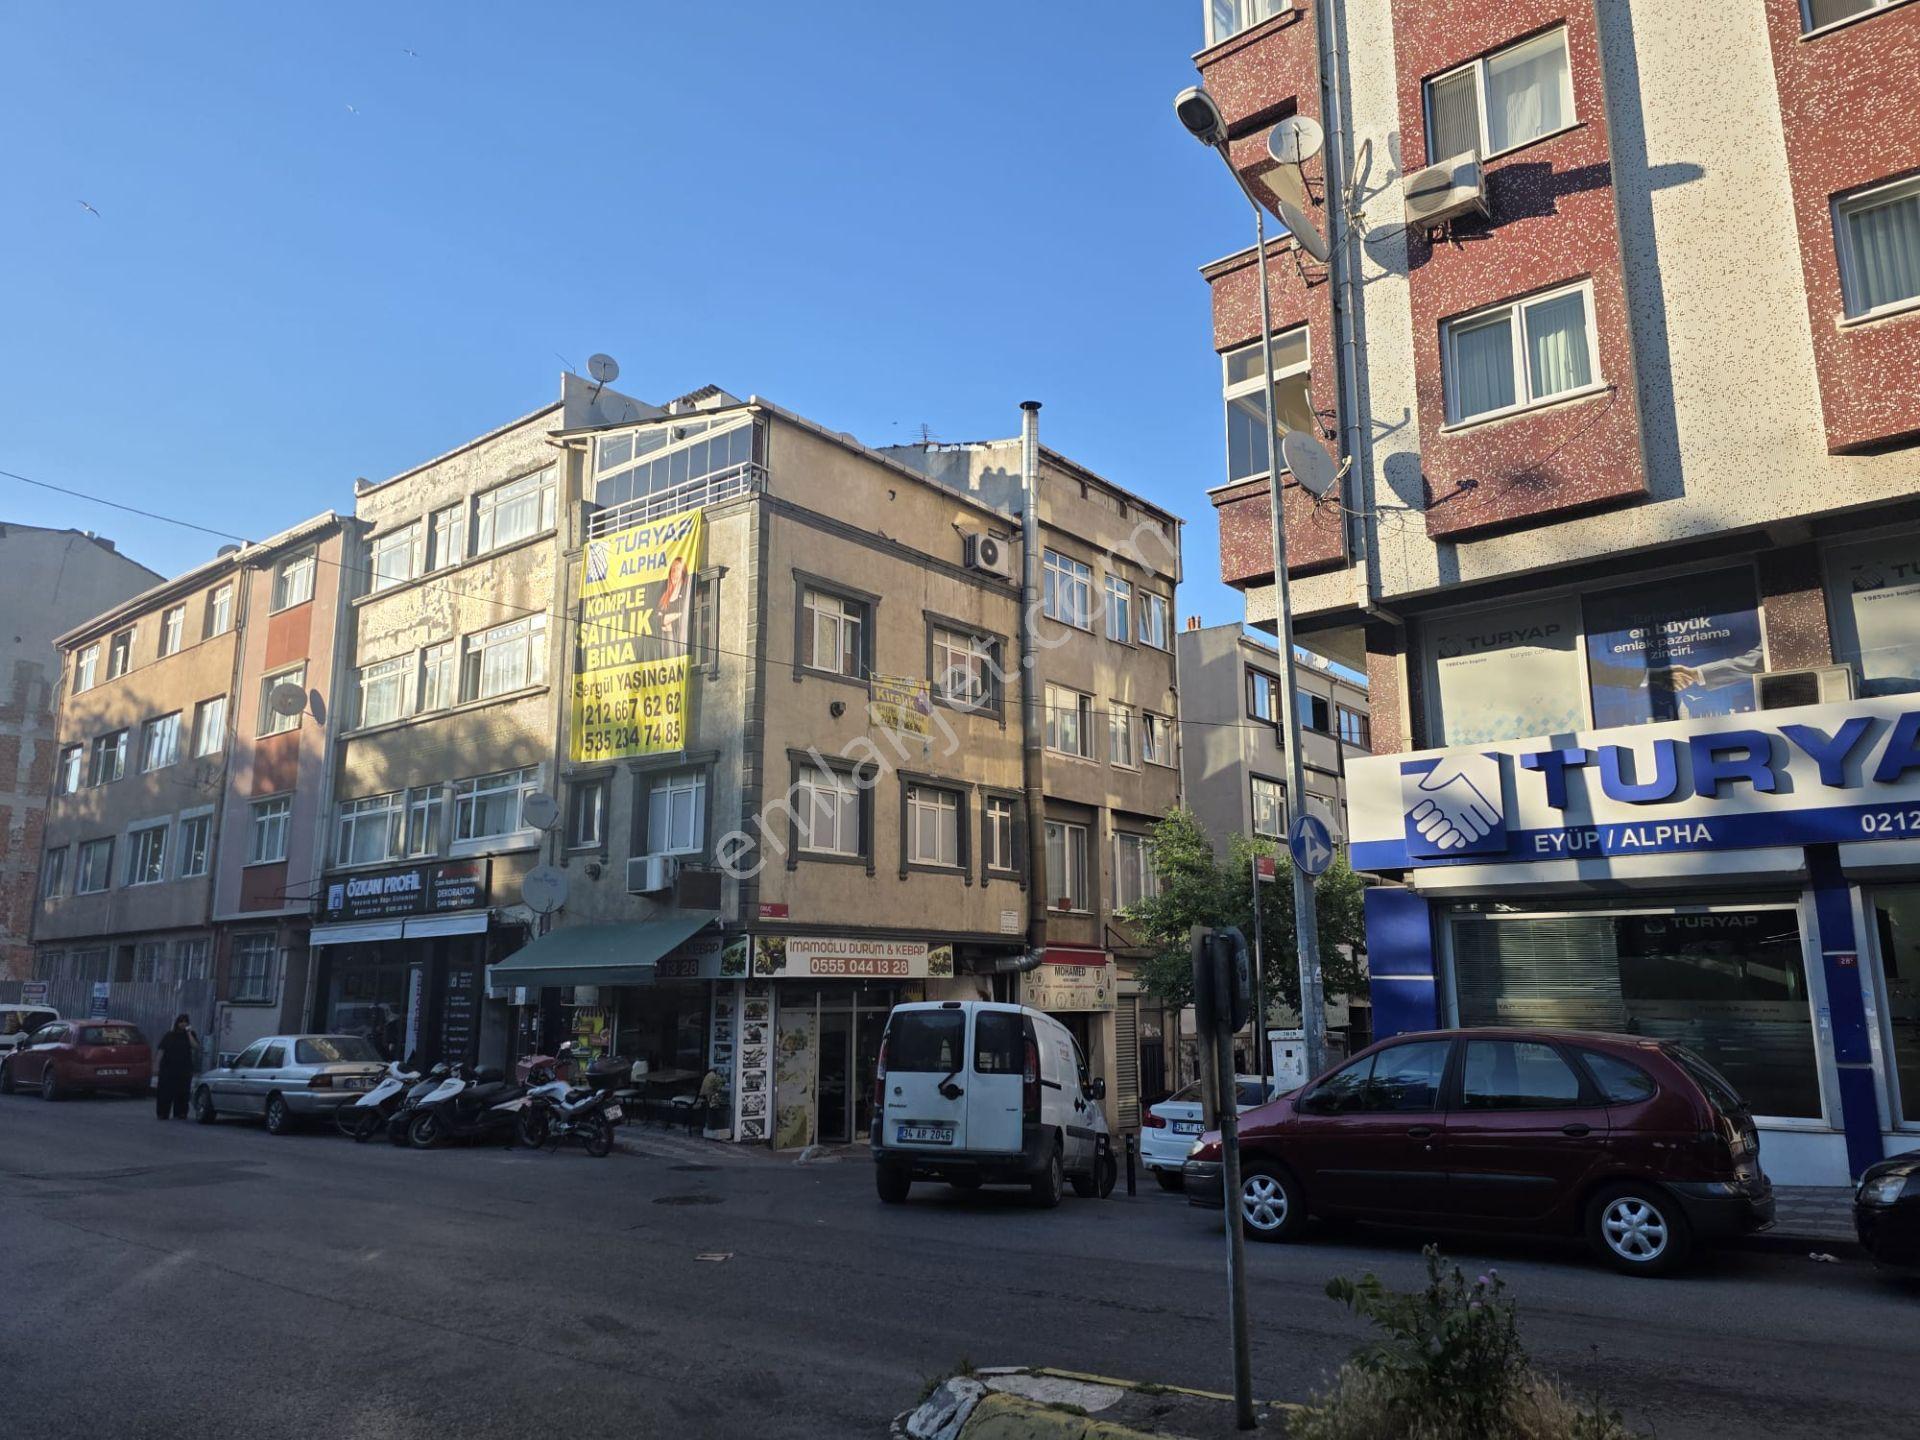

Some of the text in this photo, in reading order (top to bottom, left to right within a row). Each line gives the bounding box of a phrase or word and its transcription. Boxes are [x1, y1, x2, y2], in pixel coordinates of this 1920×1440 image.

[615, 519, 693, 555] TURYAP
[619, 551, 667, 577] ALPHA
[586, 588, 646, 618] KOMPLE
[579, 608, 653, 650] SATILIK
[1467, 624, 1561, 649] TURYAP
[1614, 628, 1730, 653] emlak pazarlama
[1629, 617, 1711, 640] en büyük
[1650, 644, 1694, 660] zinciri.
[576, 676, 613, 700] Sergül
[615, 698, 638, 722] 667
[644, 695, 661, 718] 62
[667, 691, 681, 715] 62
[615, 726, 640, 749] 234
[645, 724, 661, 746] 74
[666, 721, 680, 744] 85
[1535, 811, 1920, 853] EYÜP / ALPHA 0212
[347, 877, 383, 898] ÖZKAN
[384, 870, 422, 893] PROFİL
[437, 886, 476, 898] DEKORASYON
[1671, 915, 1760, 929] TURYAP
[887, 944, 894, 955] &
[896, 945, 925, 956] KEBAP
[811, 959, 908, 974] 0555 044 13 28
[1054, 966, 1086, 977] MOHAMED
[904, 1128, 951, 1140] 34 AR 2046
